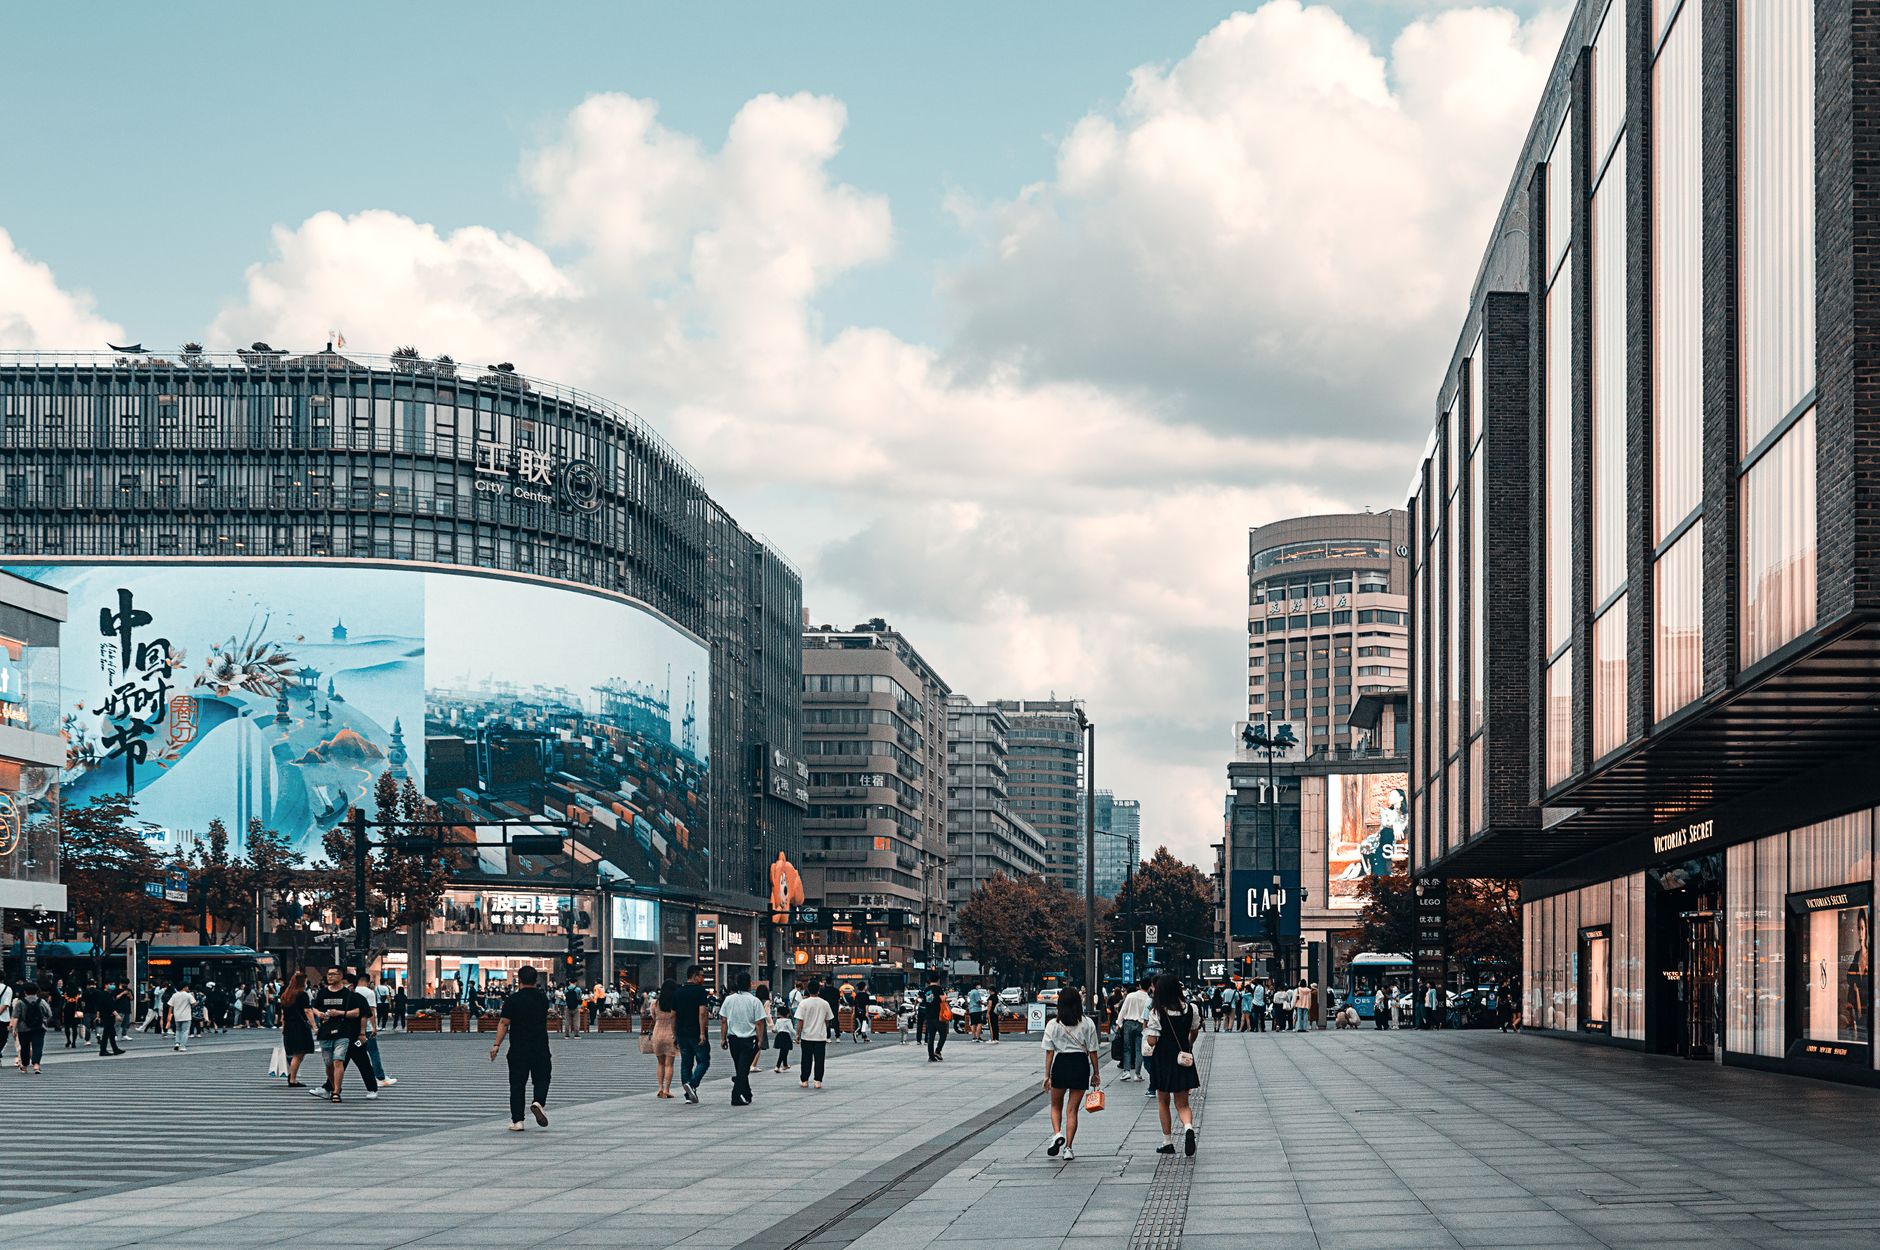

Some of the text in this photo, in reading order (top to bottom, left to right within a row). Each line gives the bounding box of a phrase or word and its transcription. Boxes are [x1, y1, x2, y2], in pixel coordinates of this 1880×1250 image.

[475, 480, 552, 504] City Center
[92, 588, 175, 798] 中国好时节
[860, 775, 884, 787] 住宿
[1653, 819, 1714, 853] VICTORIA'S SECRET
[491, 894, 559, 914] 波司登
[1247, 888, 1287, 918] GAP
[490, 914, 560, 926] 畅销全球72国
[814, 953, 850, 965] 德克士
[1209, 963, 1226, 975] 古茗
